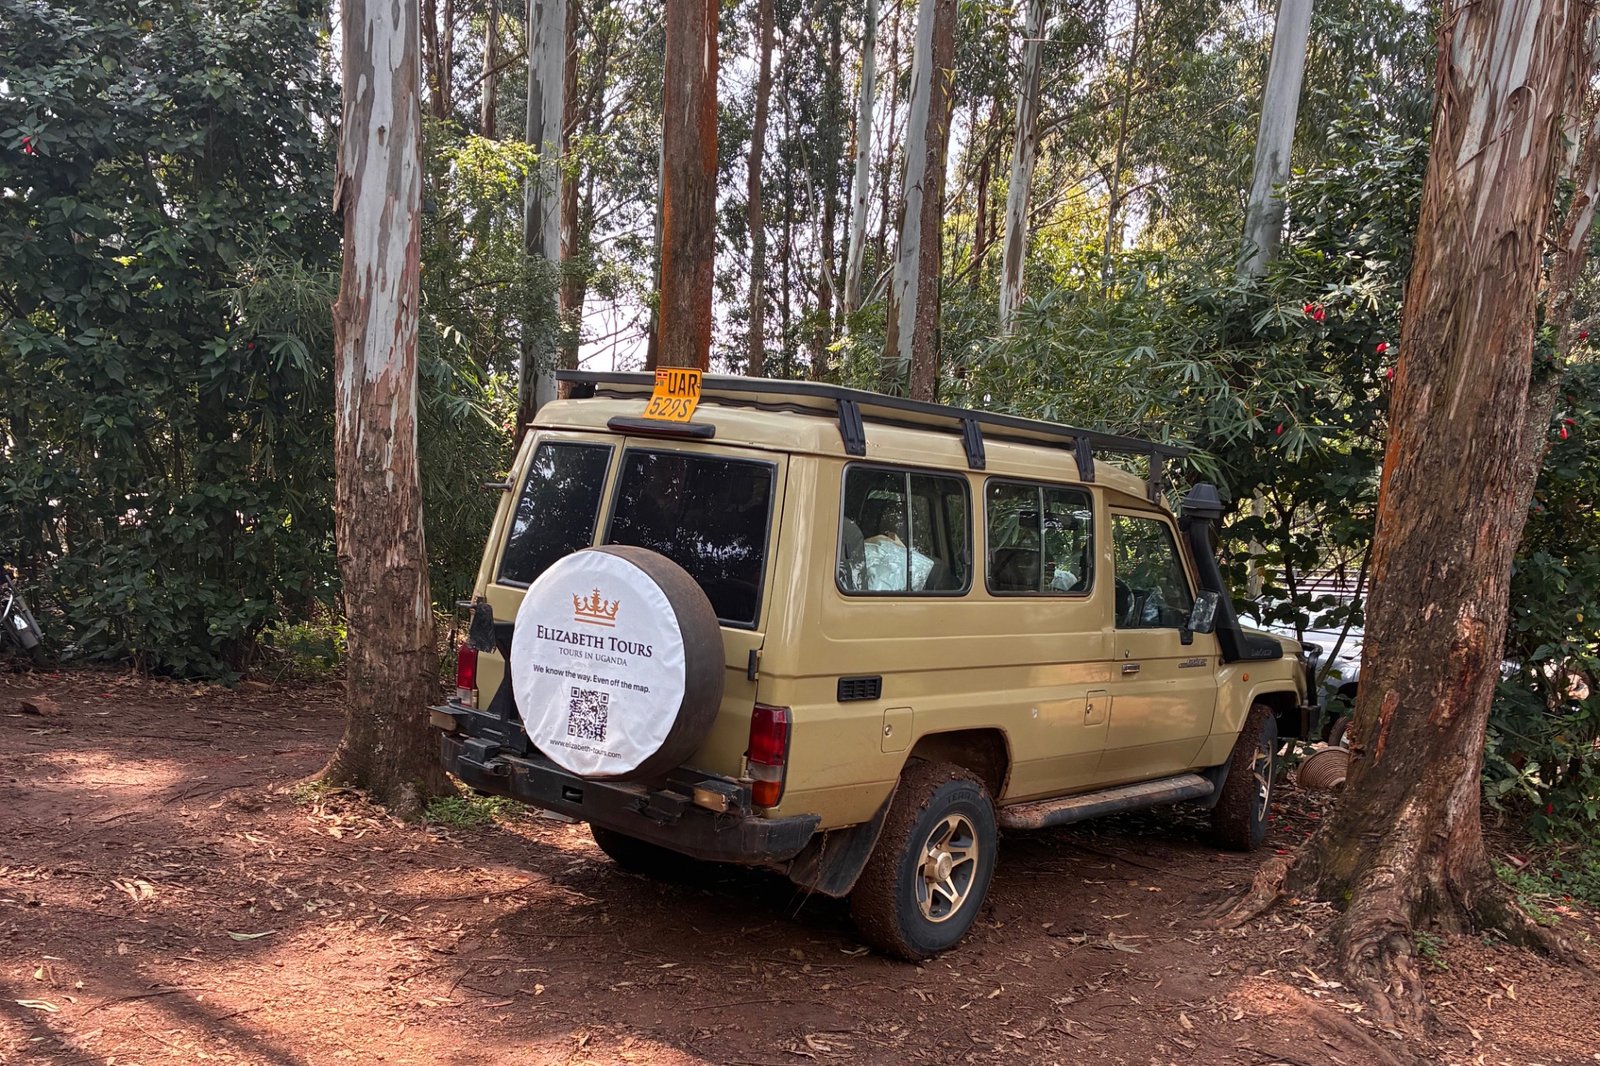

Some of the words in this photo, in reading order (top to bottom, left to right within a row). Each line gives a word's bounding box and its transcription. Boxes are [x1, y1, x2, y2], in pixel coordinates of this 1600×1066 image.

[668, 372, 698, 396] UAR
[649, 397, 692, 418] 529S
[536, 624, 604, 649] ELIZABETH
[608, 636, 653, 657] TOURS
[559, 647, 583, 658] TOURS
[585, 651, 593, 660] IN
[595, 653, 628, 666] UGANDA
[533, 664, 544, 673] We
[545, 666, 564, 676] know
[565, 670, 576, 679] the
[576, 672, 592, 683] way.
[593, 674, 609, 685] Even
[610, 678, 620, 687] off
[621, 680, 632, 690] the
[633, 684, 651, 694] map.
[549, 739, 622, 759] www.elizabeth-tours.com
